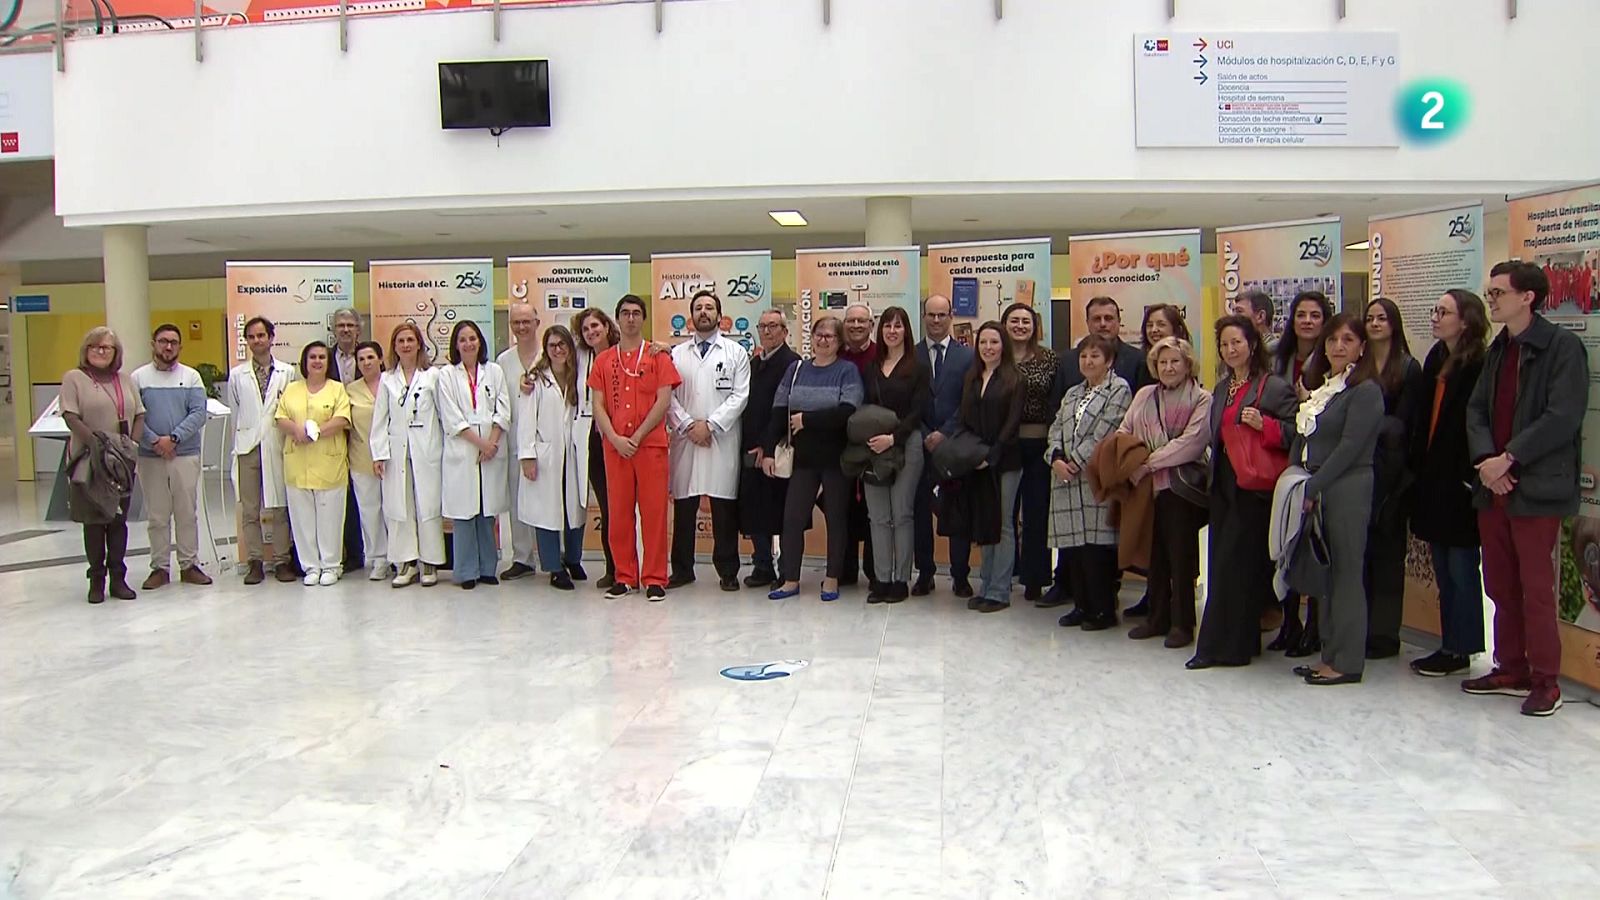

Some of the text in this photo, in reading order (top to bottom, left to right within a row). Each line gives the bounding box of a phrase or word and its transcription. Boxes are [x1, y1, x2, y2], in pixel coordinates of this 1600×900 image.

[1217, 40, 1234, 49] UCI
[1217, 56, 1395, 67] Módulos de hospitalización C, D, E, F y G
[1217, 73, 1237, 81] Salón
[1239, 73, 1248, 81] de
[1263, 127, 1286, 135] sangre
[1256, 136, 1281, 144] Terapia
[1527, 208, 1558, 221] Hospital
[1536, 218, 1599, 233] Puerta de Hierro
[1523, 234, 1576, 249] Majadahonda
[961, 253, 1008, 263] respuesta
[1011, 252, 1035, 261] para
[1092, 245, 1190, 273] ¿Por qué
[949, 263, 1025, 275] cada necesidad
[537, 275, 609, 284] MINIATURIZACIÓN
[1078, 273, 1160, 284] somos conocidos?
[237, 284, 288, 295] Exposición
[378, 280, 449, 289] Historia del I.C.
[234, 313, 248, 360] España
